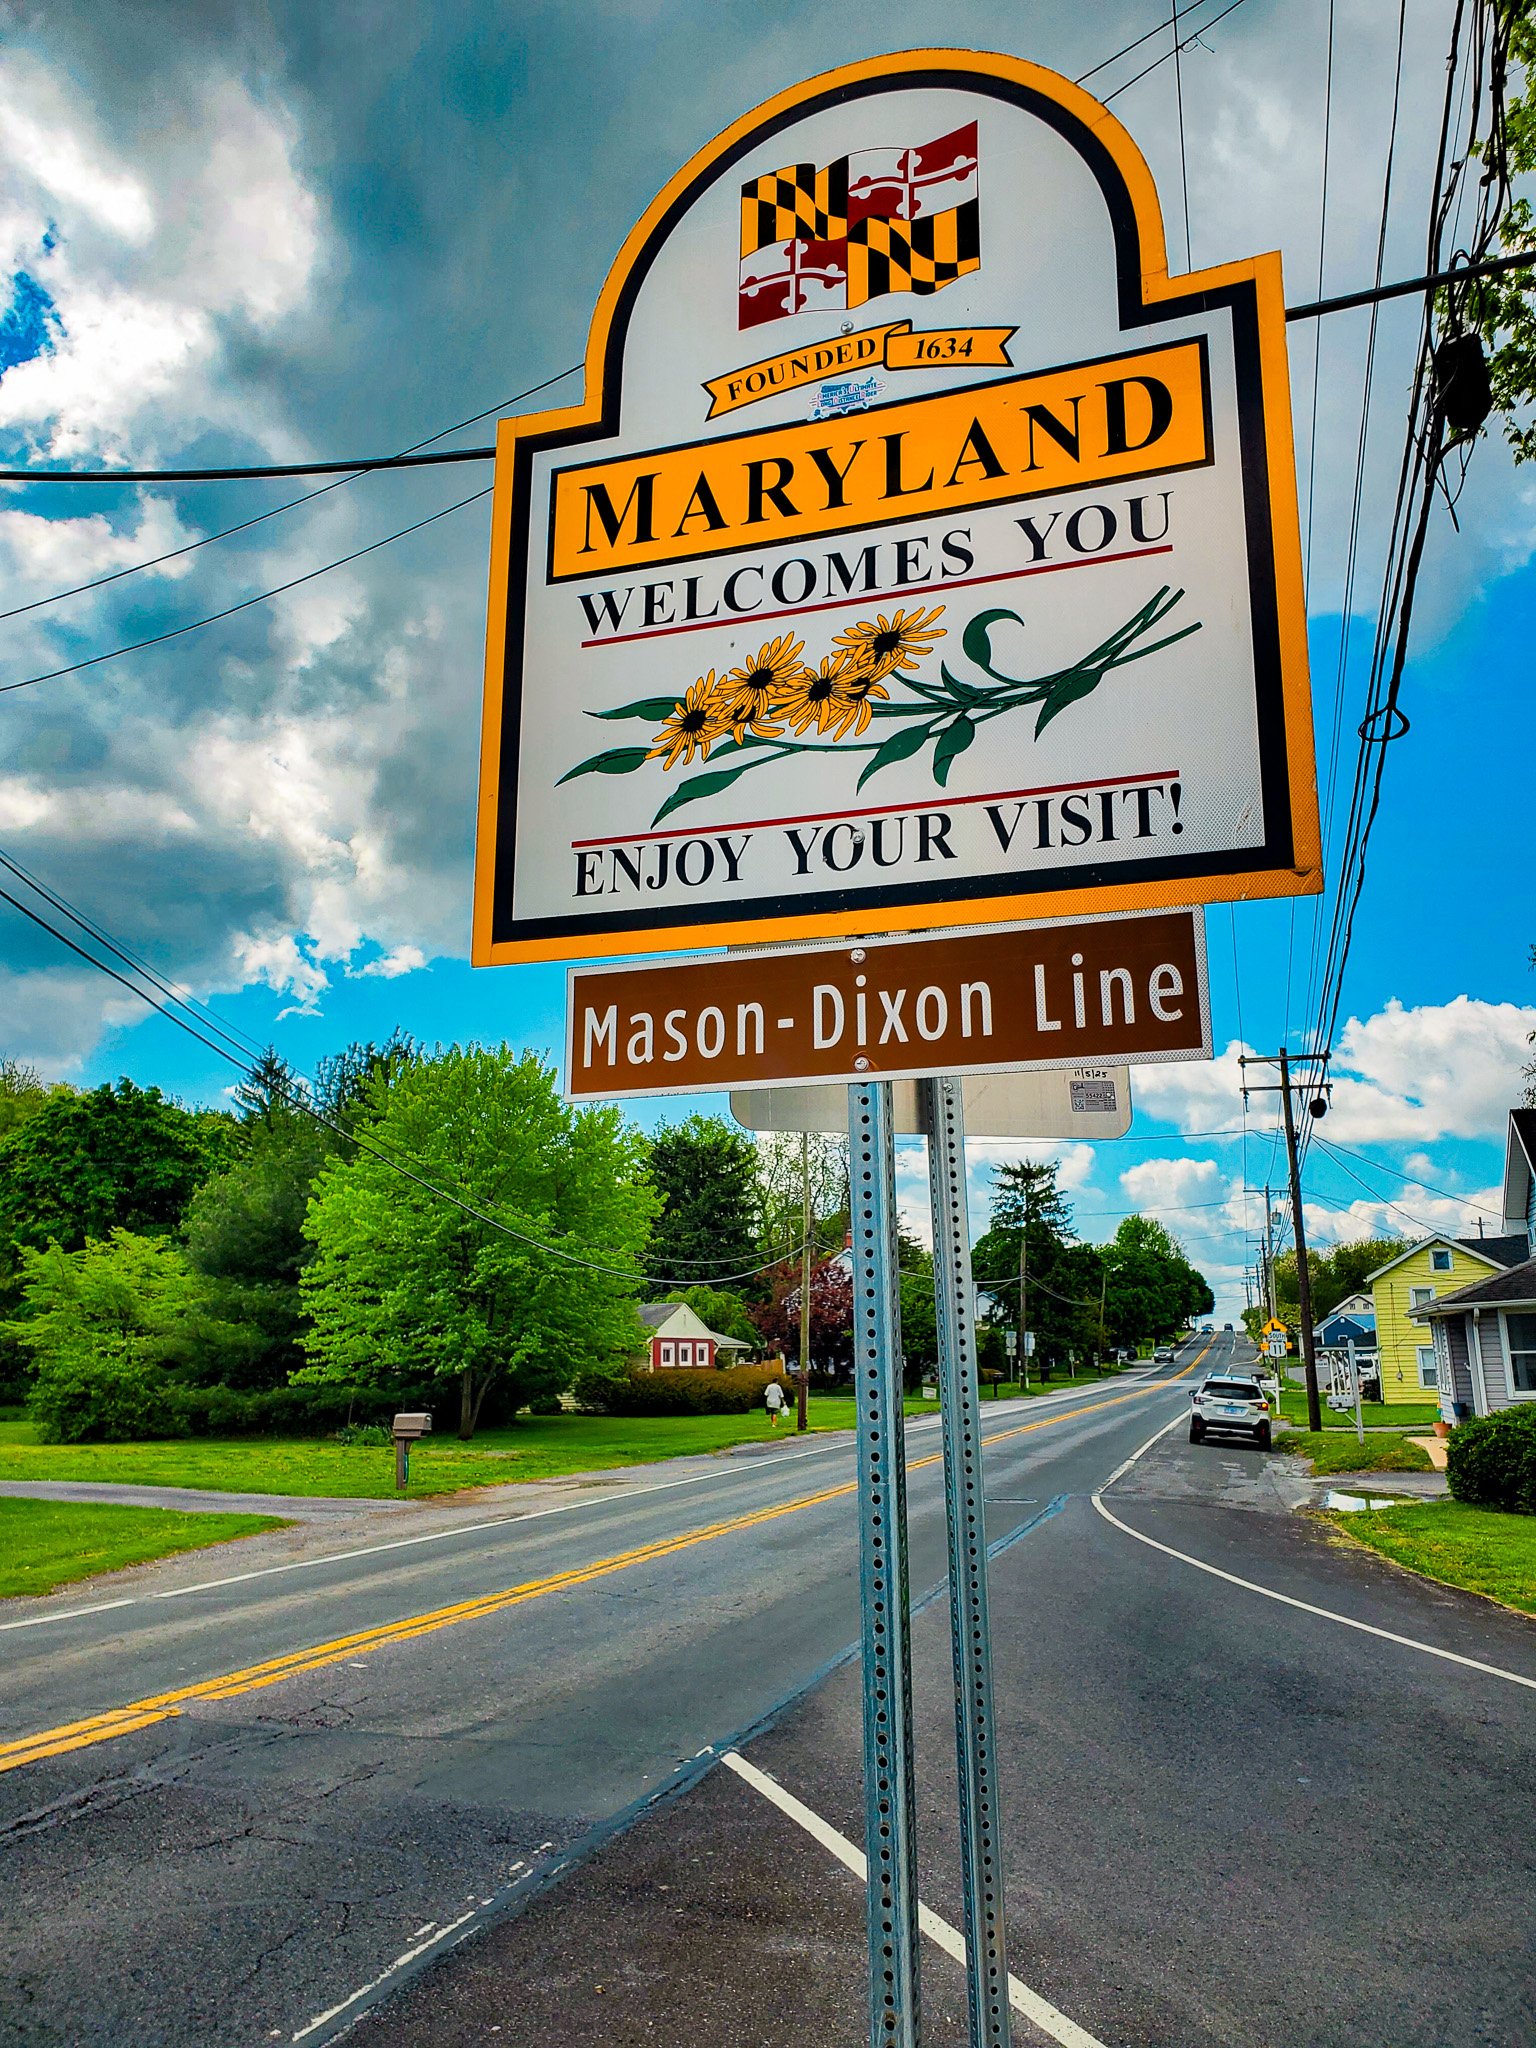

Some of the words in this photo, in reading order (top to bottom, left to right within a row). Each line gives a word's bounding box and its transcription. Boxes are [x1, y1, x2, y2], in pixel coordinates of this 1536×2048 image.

[727, 338, 877, 402] FOUNDED
[914, 336, 974, 360] 1634
[834, 394, 860, 405] DISTANCE
[860, 390, 878, 399] RIDER
[849, 381, 878, 393] ULTIMATE
[576, 375, 1174, 554] MARYLAND
[576, 528, 975, 636] WELCOMES
[1014, 491, 1174, 563] YOU
[571, 834, 753, 898] ENJOY
[783, 812, 957, 876] YOUR
[983, 782, 1184, 854] VISIT!
[582, 974, 994, 1069] Mason-Dixon
[1034, 952, 1186, 1032] Line
[1273, 1344, 1282, 1355] 11
